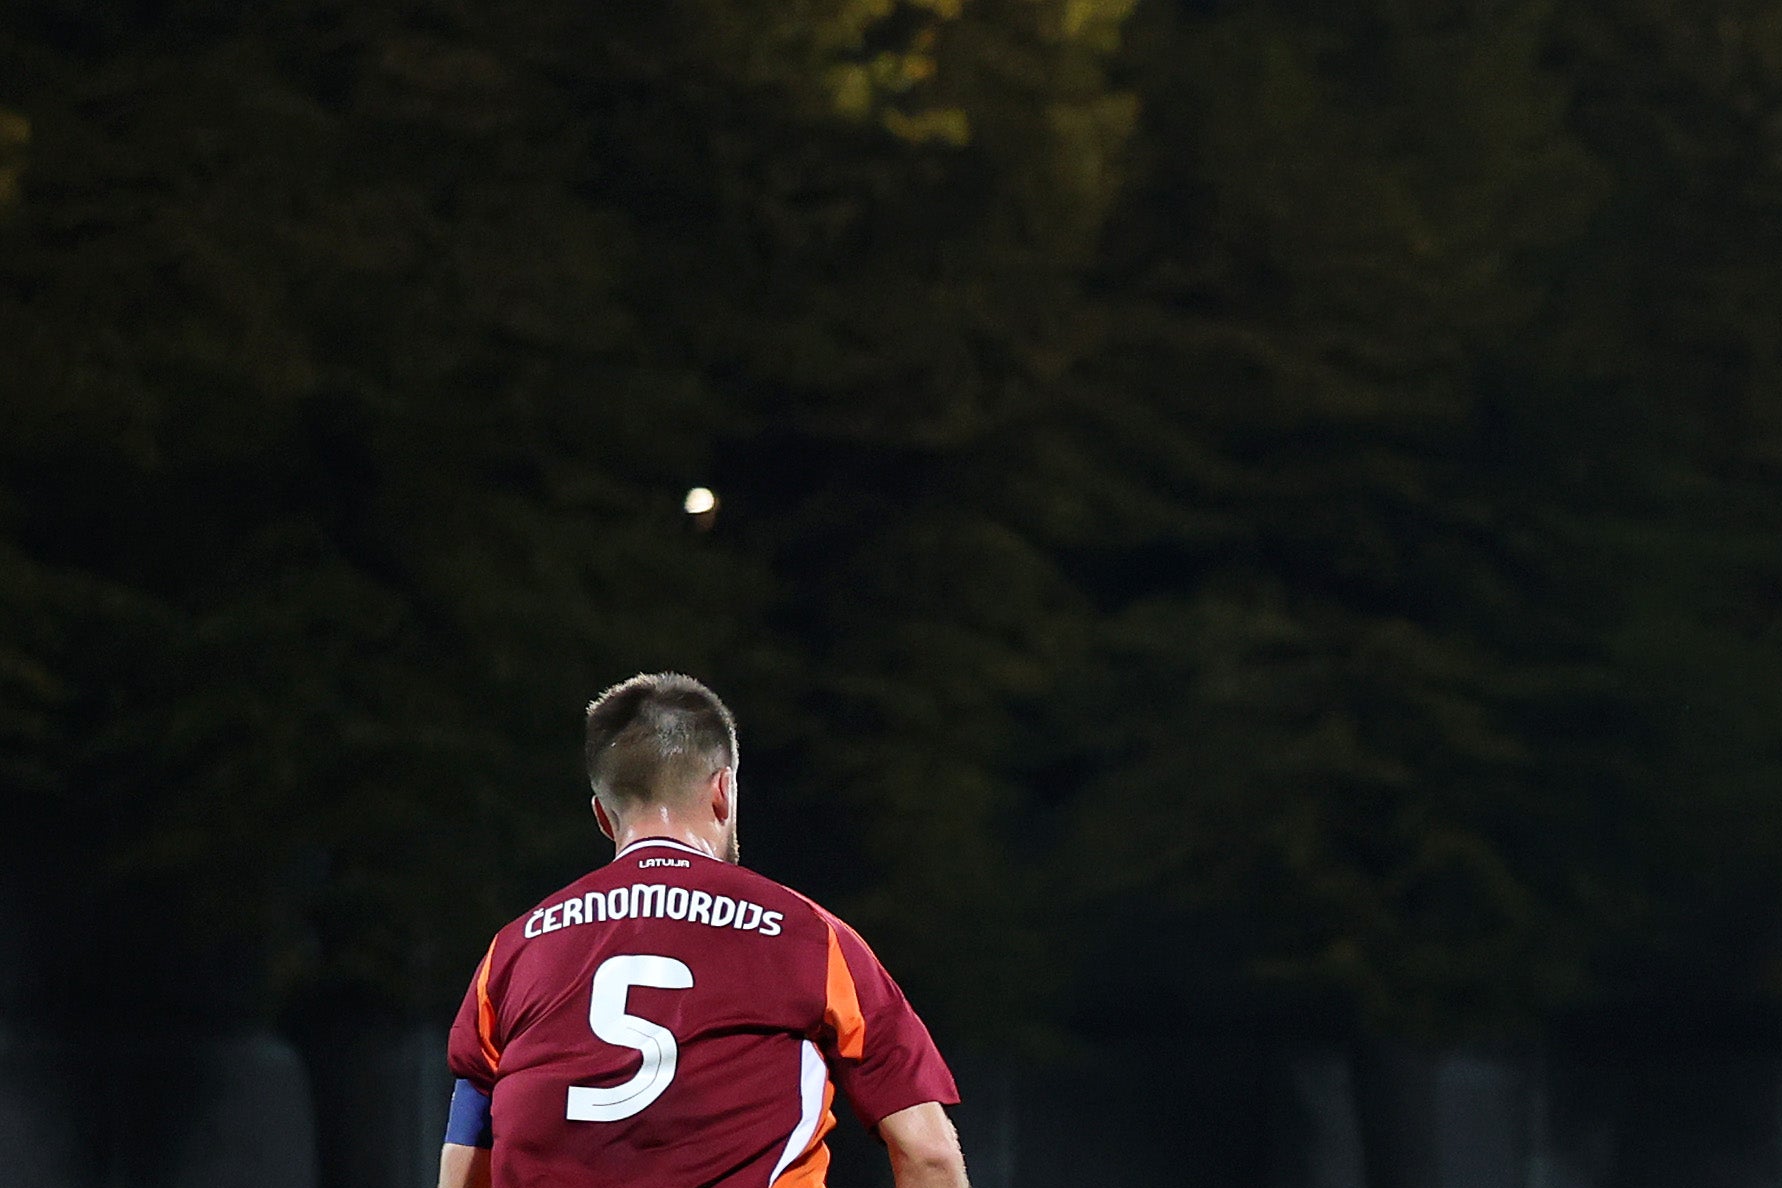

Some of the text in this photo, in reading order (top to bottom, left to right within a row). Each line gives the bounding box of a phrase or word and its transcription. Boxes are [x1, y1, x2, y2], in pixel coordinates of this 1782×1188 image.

[639, 858, 690, 868] LATVIJA
[524, 884, 784, 939] ČERNOMORDIJS
[566, 954, 694, 1122] 5
